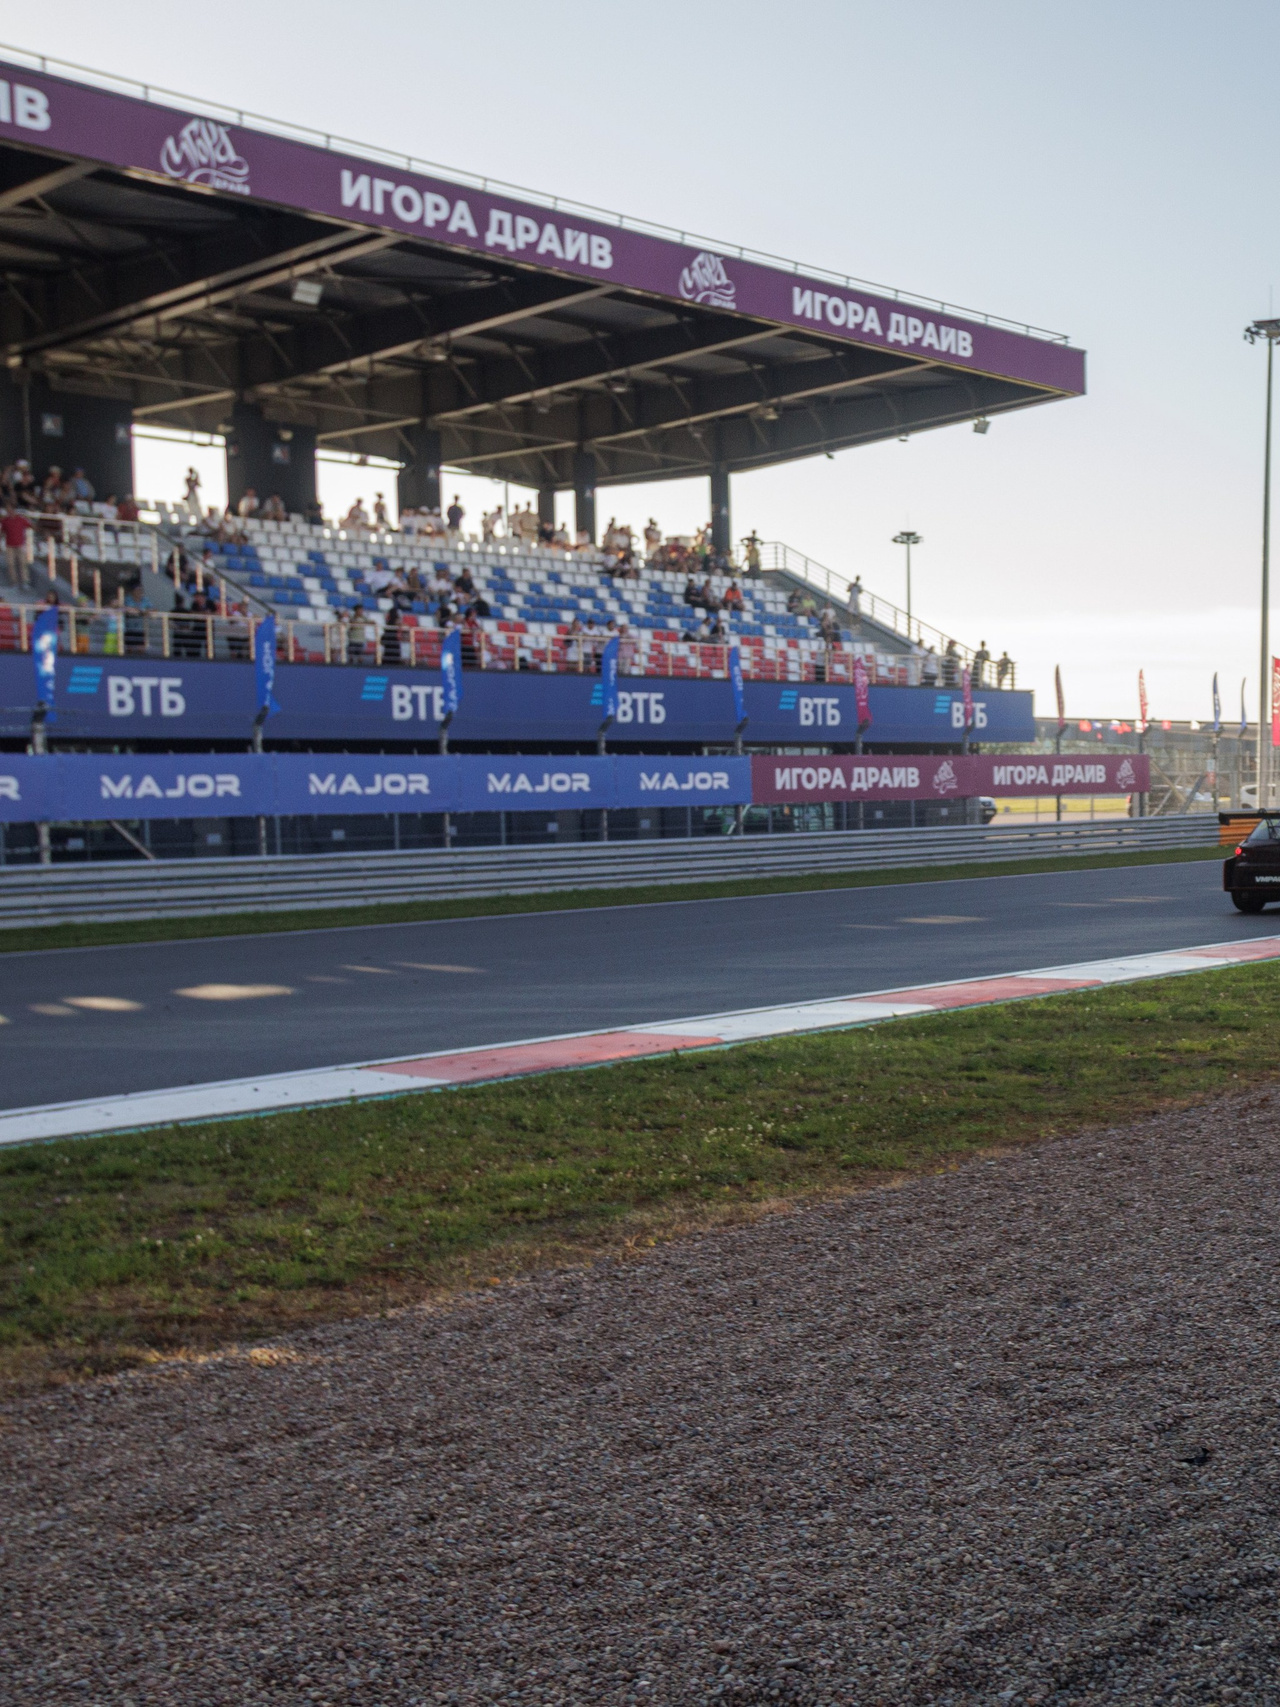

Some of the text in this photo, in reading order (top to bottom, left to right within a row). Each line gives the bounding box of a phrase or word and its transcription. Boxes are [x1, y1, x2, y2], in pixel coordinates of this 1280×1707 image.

[340, 170, 614, 270] ИГОРА ДРАЙВ
[792, 286, 974, 358] ИГОРА ДРАЙВ
[107, 675, 186, 717] ВТБ
[616, 691, 666, 724] ВТБ
[799, 697, 841, 726] ВТБ
[952, 702, 988, 729] ВБ
[100, 774, 241, 799] MAJOR
[309, 773, 430, 795] MAJOR
[488, 773, 591, 793] MAJOR
[639, 772, 730, 790] MAJOR
[775, 767, 846, 791] ИГОРА
[993, 765, 1049, 786] ИГОРА
